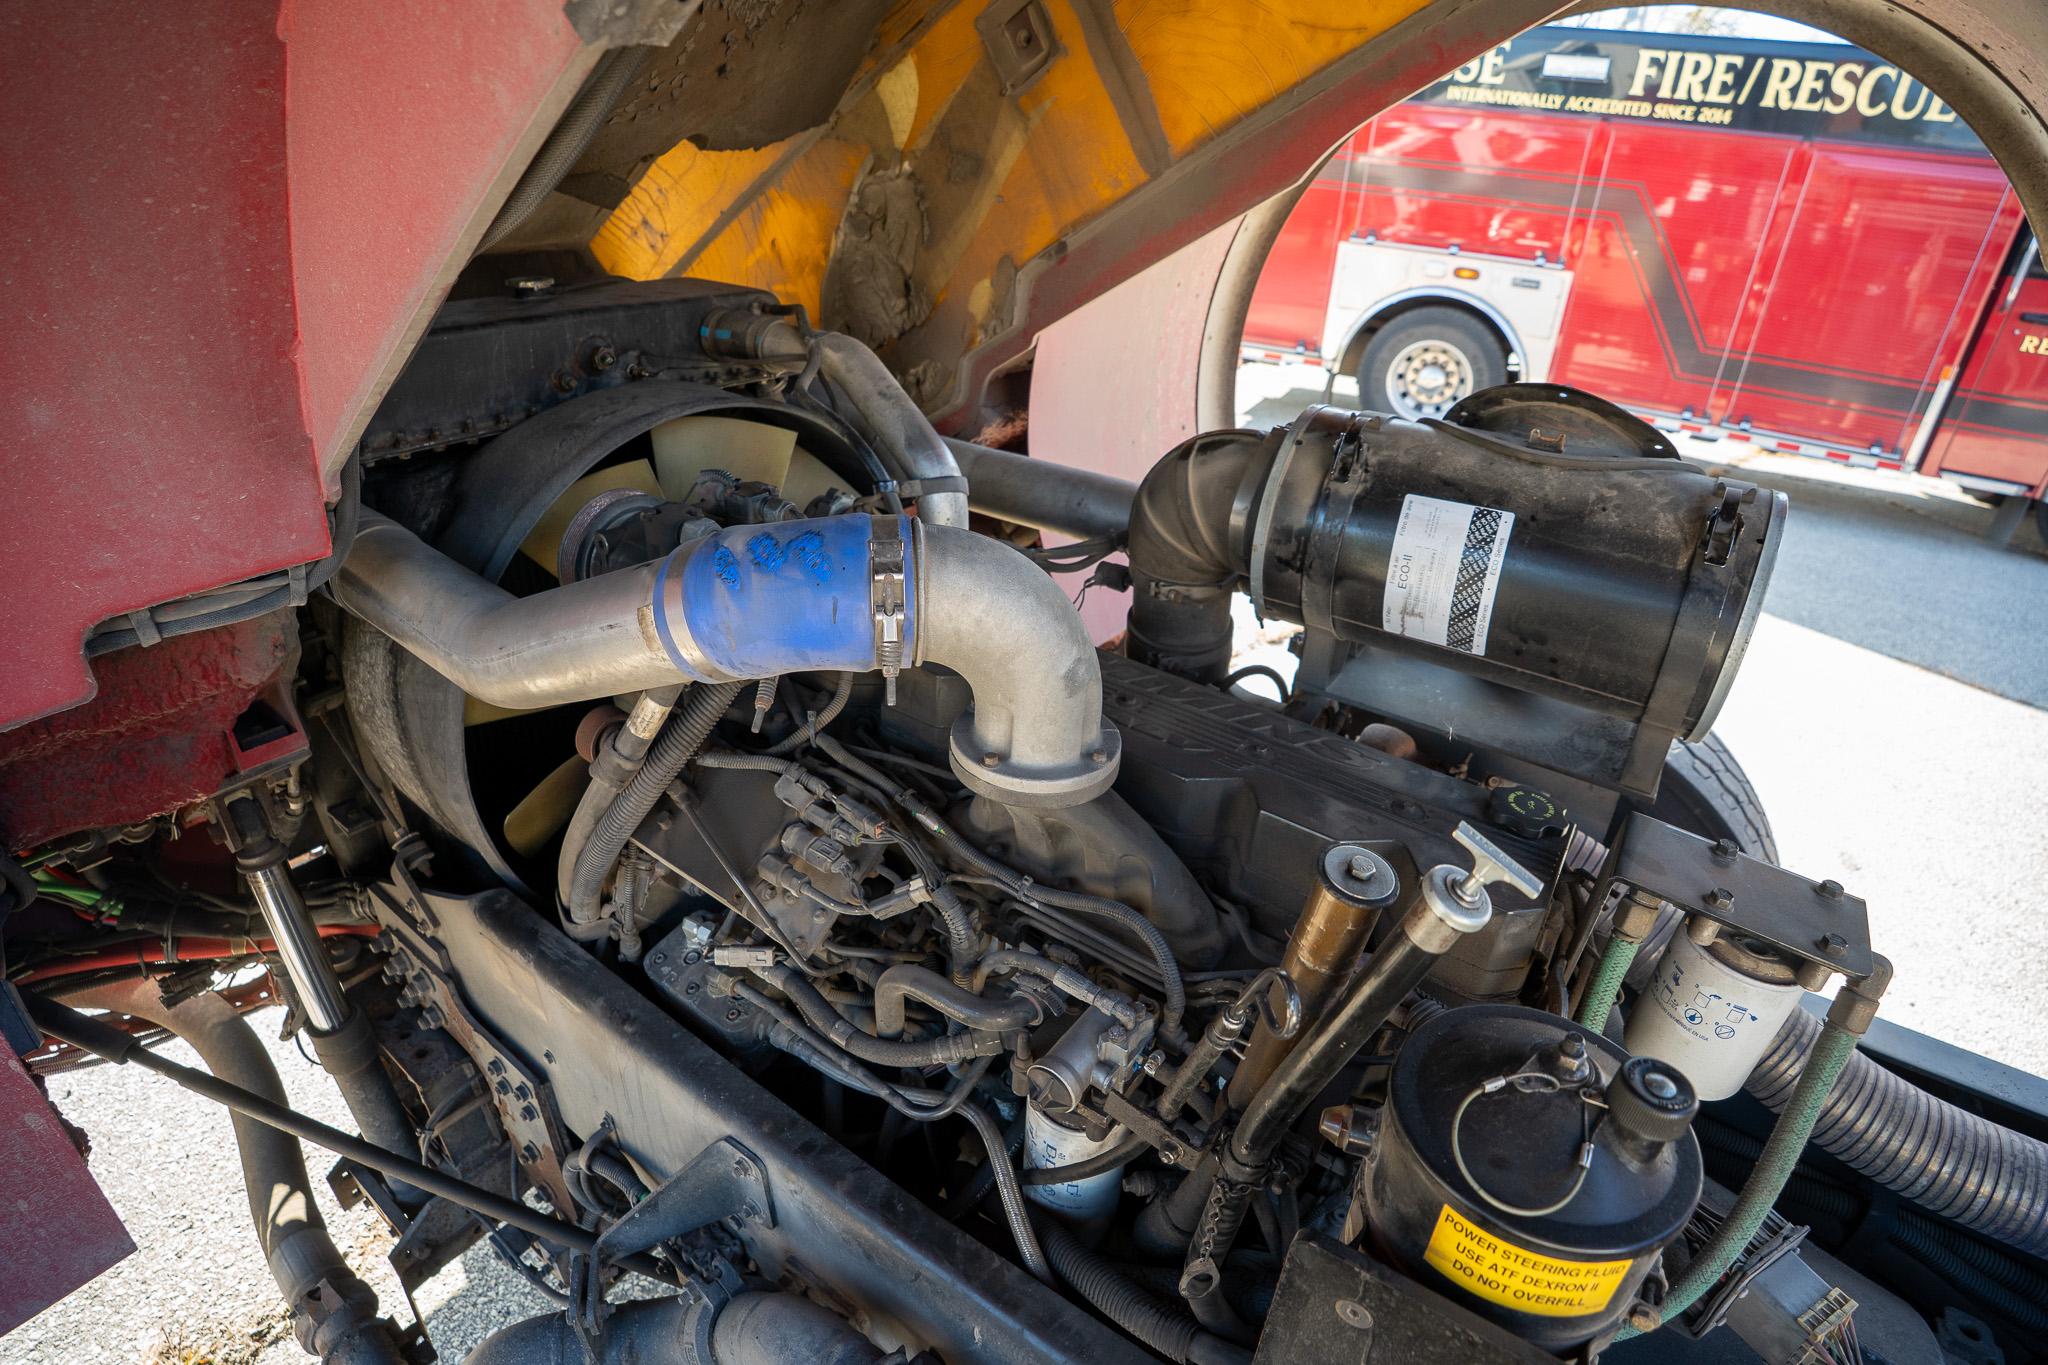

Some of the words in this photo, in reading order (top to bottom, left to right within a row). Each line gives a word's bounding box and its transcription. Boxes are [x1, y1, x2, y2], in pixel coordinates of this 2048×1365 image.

[1446, 85, 1565, 110] INTERNATIONALLY
[1565, 96, 1652, 117] ACCREDITED
[1653, 102, 1697, 121] SINCE
[1697, 106, 1733, 125] 2014
[1445, 1213, 1498, 1254] POWER
[1500, 1249, 1580, 1278] STEERING
[1584, 1264, 1626, 1278] FLUID
[1456, 1242, 1486, 1267] USE
[1488, 1262, 1519, 1279] ATF
[1522, 1274, 1588, 1293] DEXRON
[1590, 1283, 1600, 1292] II
[1452, 1258, 1474, 1278] DO
[1477, 1273, 1511, 1294] NOT
[1513, 1289, 1585, 1308] OVERFILL
